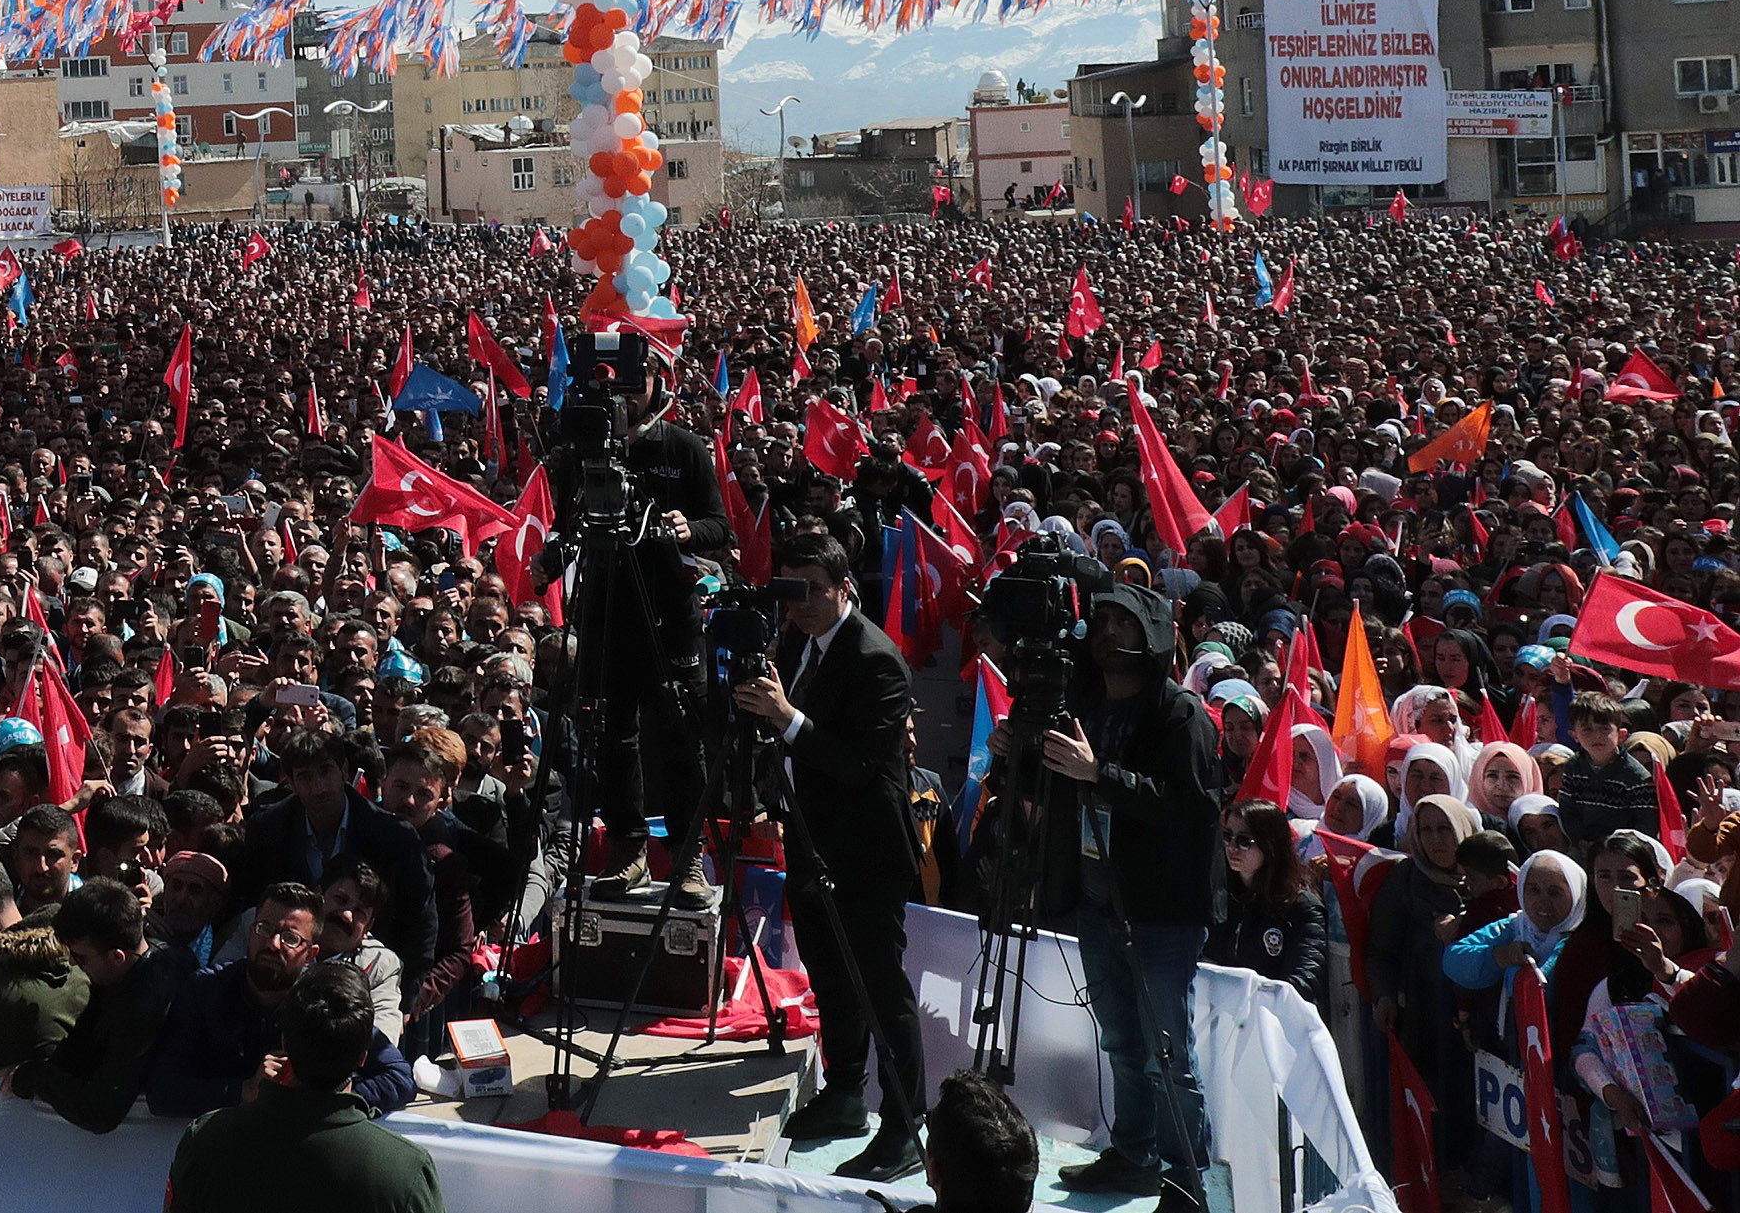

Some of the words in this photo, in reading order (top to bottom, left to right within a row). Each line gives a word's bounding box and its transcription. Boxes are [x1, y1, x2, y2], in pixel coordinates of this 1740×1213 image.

[1269, 28, 1377, 61] TEŞRİFLERİNİZ
[1280, 64, 1428, 92] ONURLANDIRMIŞTIR
[1303, 91, 1403, 123] HOŞGELDİNİZ
[1278, 160, 1290, 172] AK
[1293, 158, 1320, 172] PARTİ
[1322, 159, 1359, 175] ŞIRNAK
